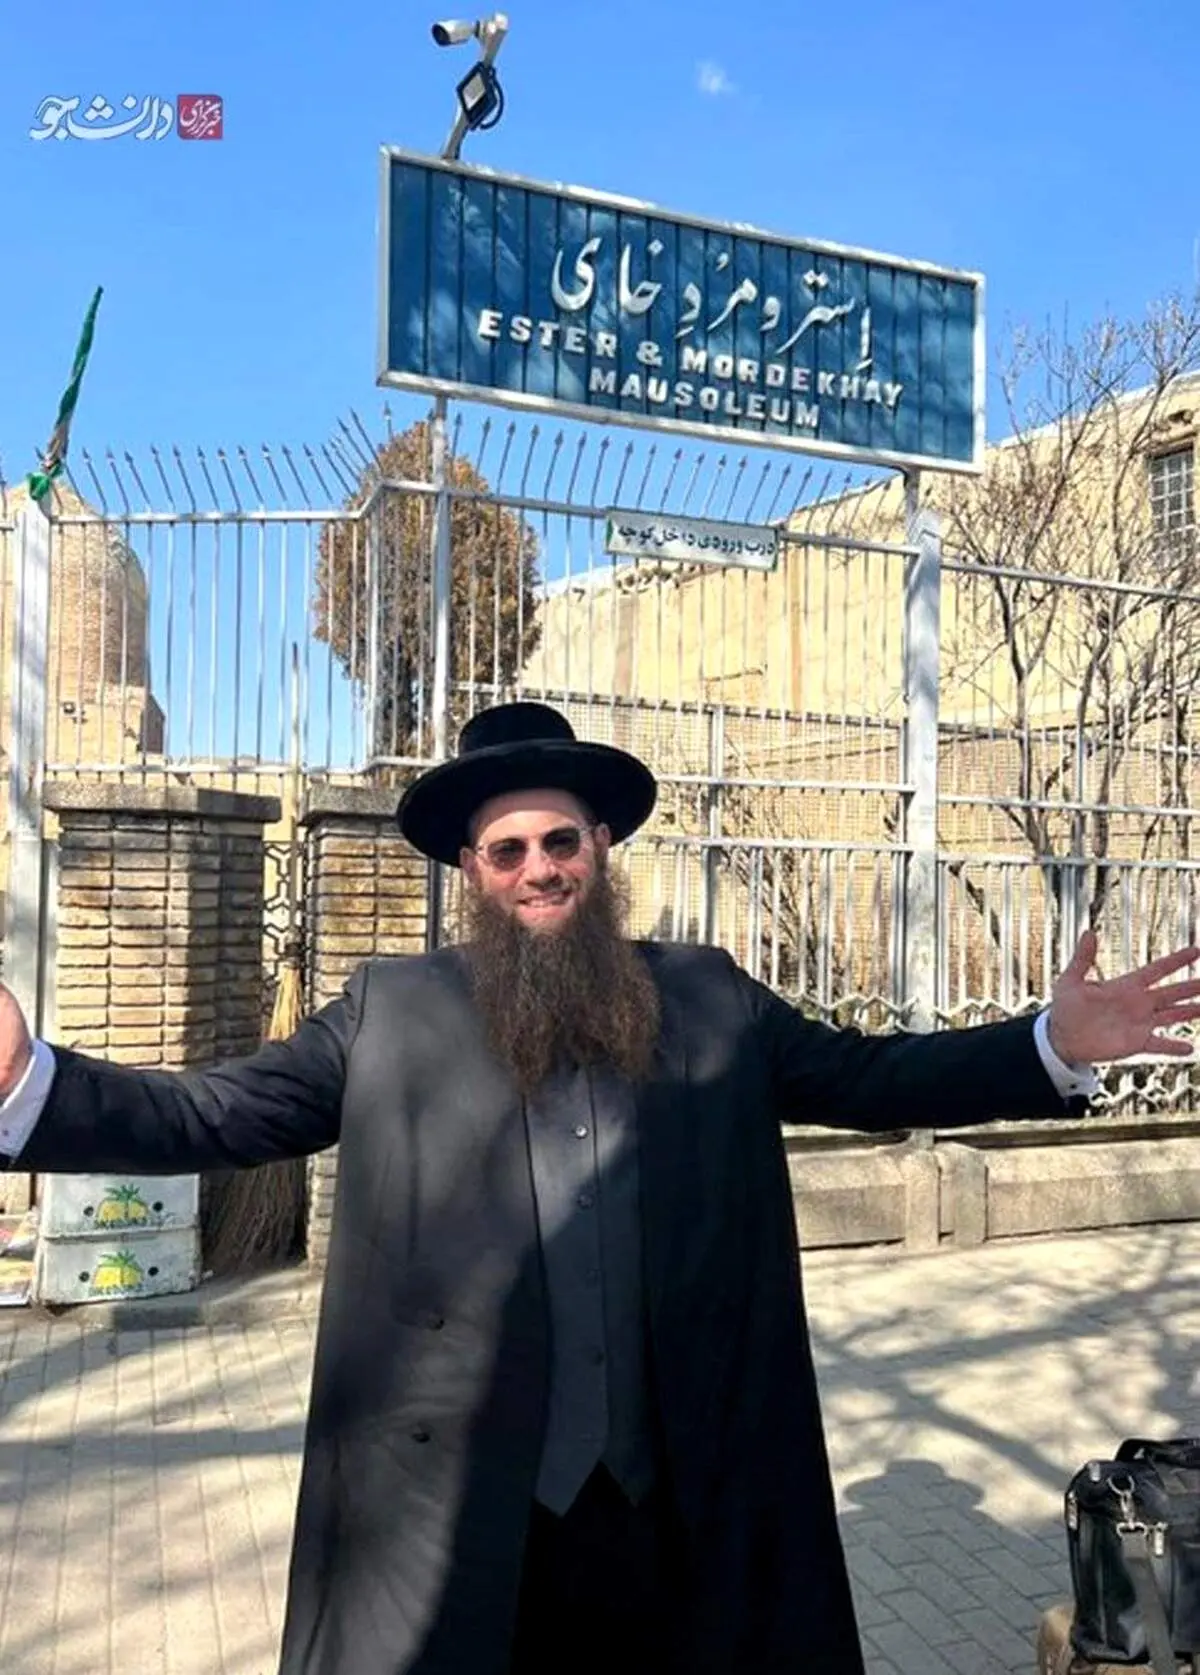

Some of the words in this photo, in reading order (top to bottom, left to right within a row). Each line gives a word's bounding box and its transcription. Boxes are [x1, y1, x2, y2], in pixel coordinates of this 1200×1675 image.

[759, 297, 781, 332] و
[477, 308, 617, 358] ESTER
[636, 340, 663, 366] &
[681, 345, 903, 408] MORDEKHAY
[588, 366, 820, 428] MAUSOLEUM
[697, 535, 743, 554] ورودی
[744, 541, 775, 556] درب
